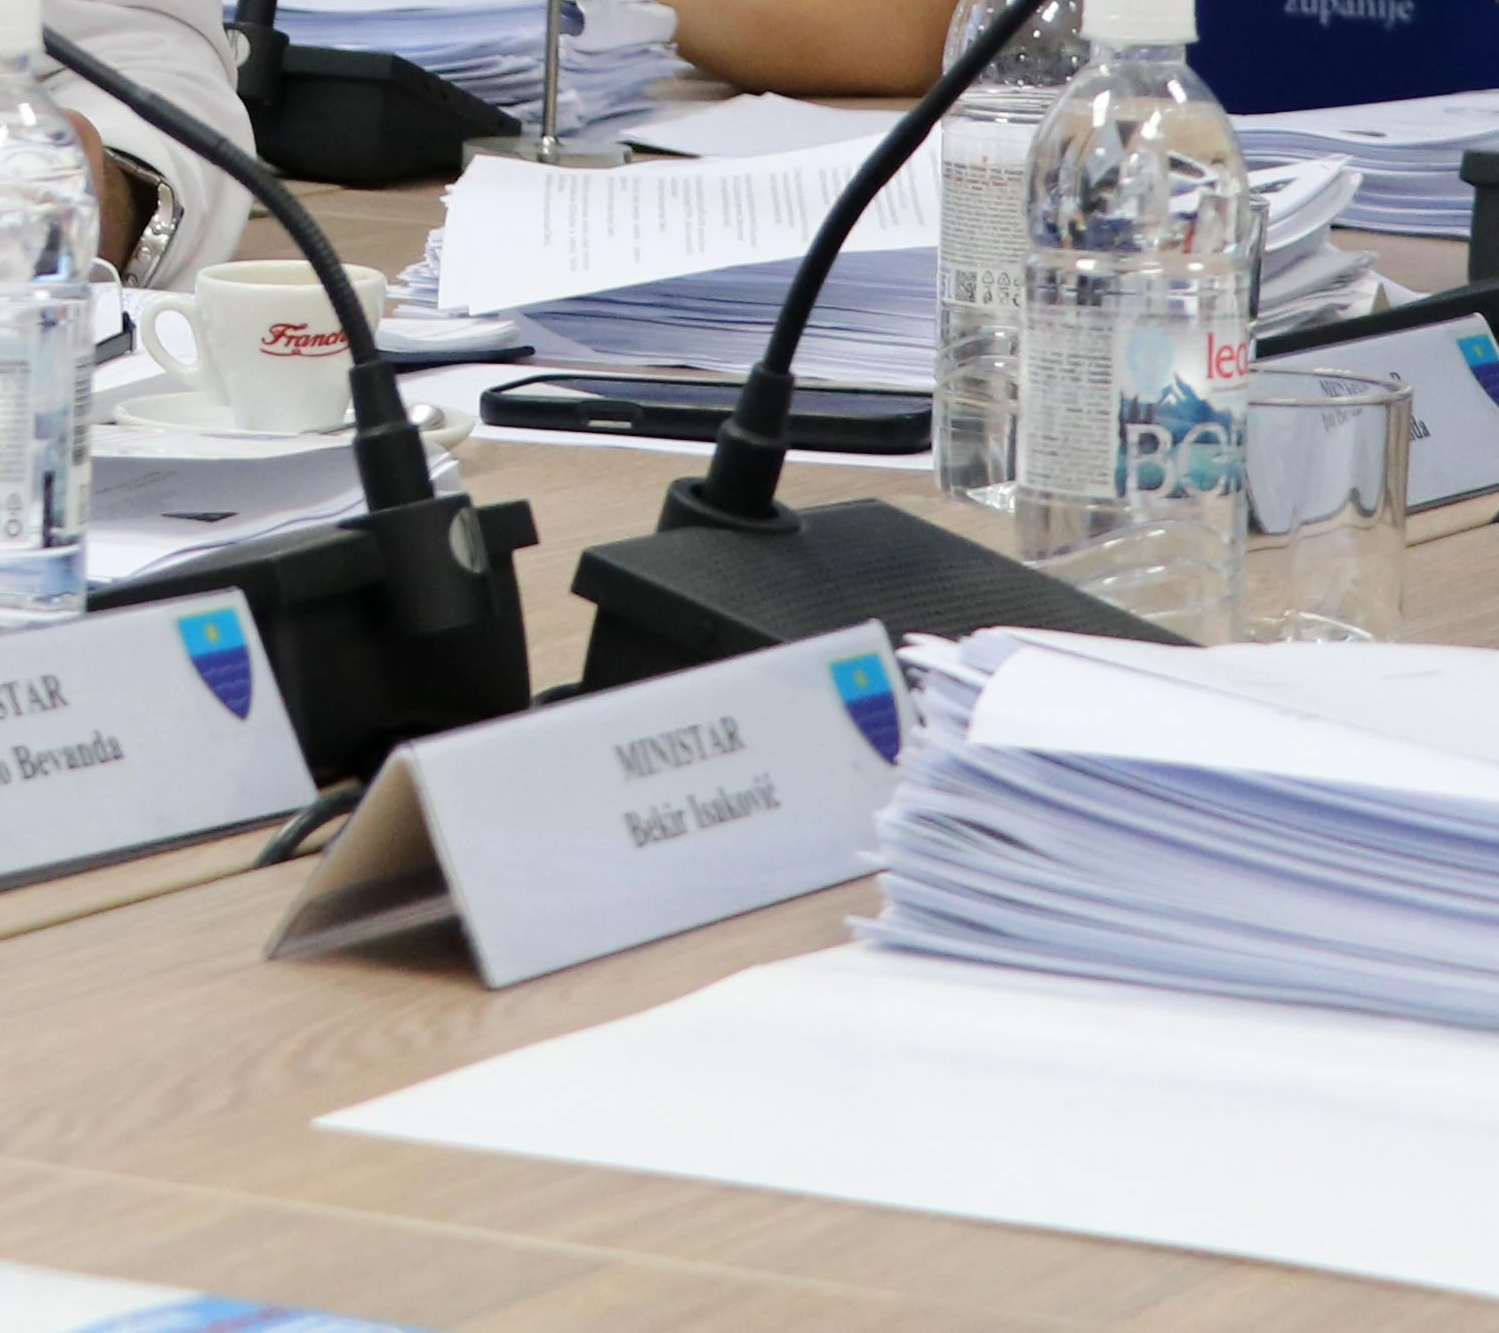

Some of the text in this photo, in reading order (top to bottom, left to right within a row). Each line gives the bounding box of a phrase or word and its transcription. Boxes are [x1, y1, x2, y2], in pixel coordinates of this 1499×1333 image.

[261, 322, 351, 349] Franc
[12, 728, 125, 781] Bevanda
[612, 714, 748, 784] MINISTAR
